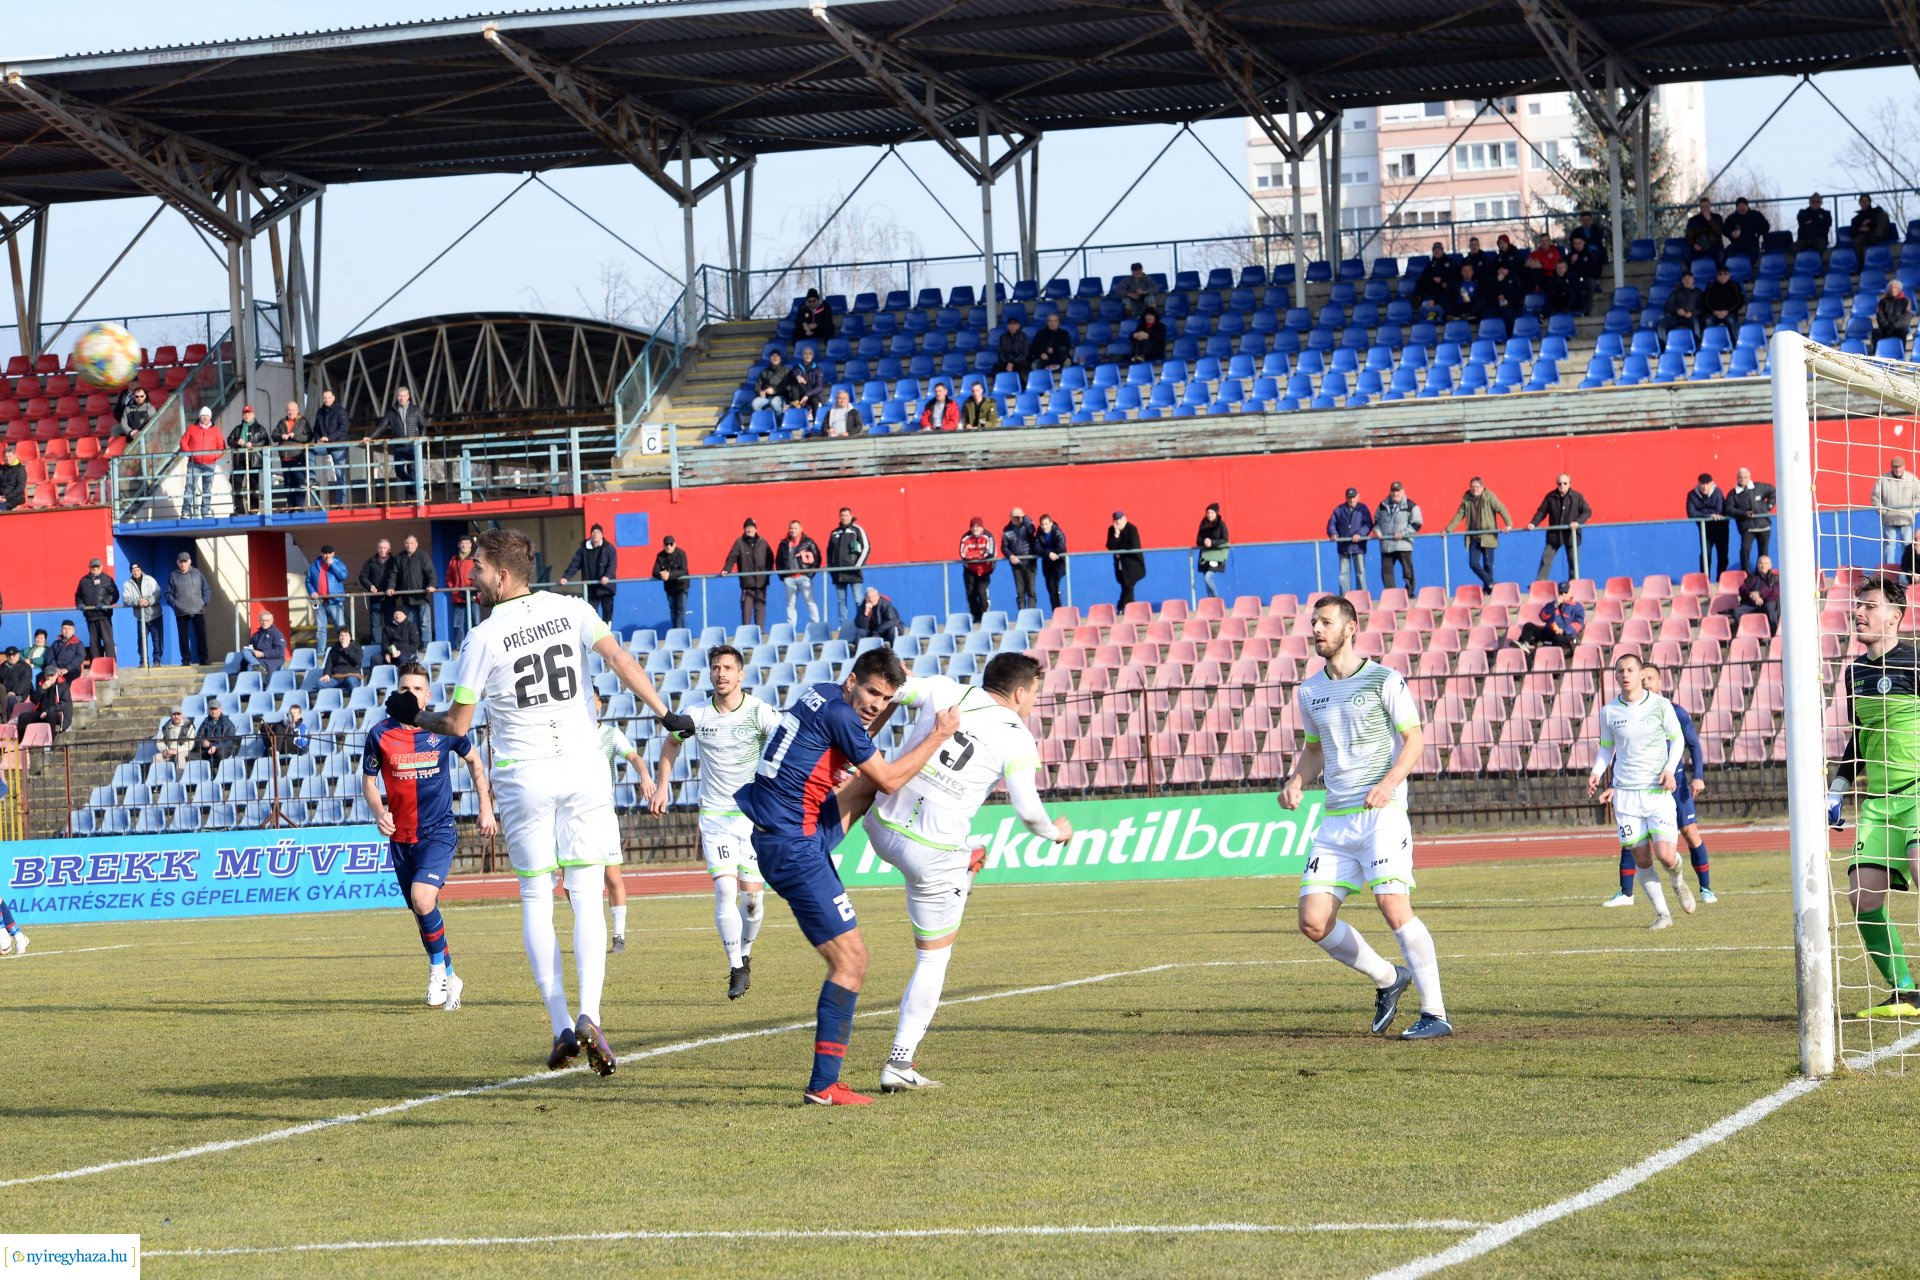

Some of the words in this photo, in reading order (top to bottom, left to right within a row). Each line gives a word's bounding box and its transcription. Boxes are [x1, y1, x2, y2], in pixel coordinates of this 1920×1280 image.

[647, 436, 657, 451] C
[503, 617, 572, 652] PRÉSINGER
[513, 643, 577, 709] 26
[920, 763, 967, 797] ONTEX
[9, 849, 199, 888] BREKK
[717, 845, 730, 860] 16
[8, 890, 145, 914] ALKATRÉSZEK
[150, 886, 176, 908] ÉS
[181, 886, 302, 907] GÉPELEMEK
[307, 878, 403, 901] GYÁRTÁS
